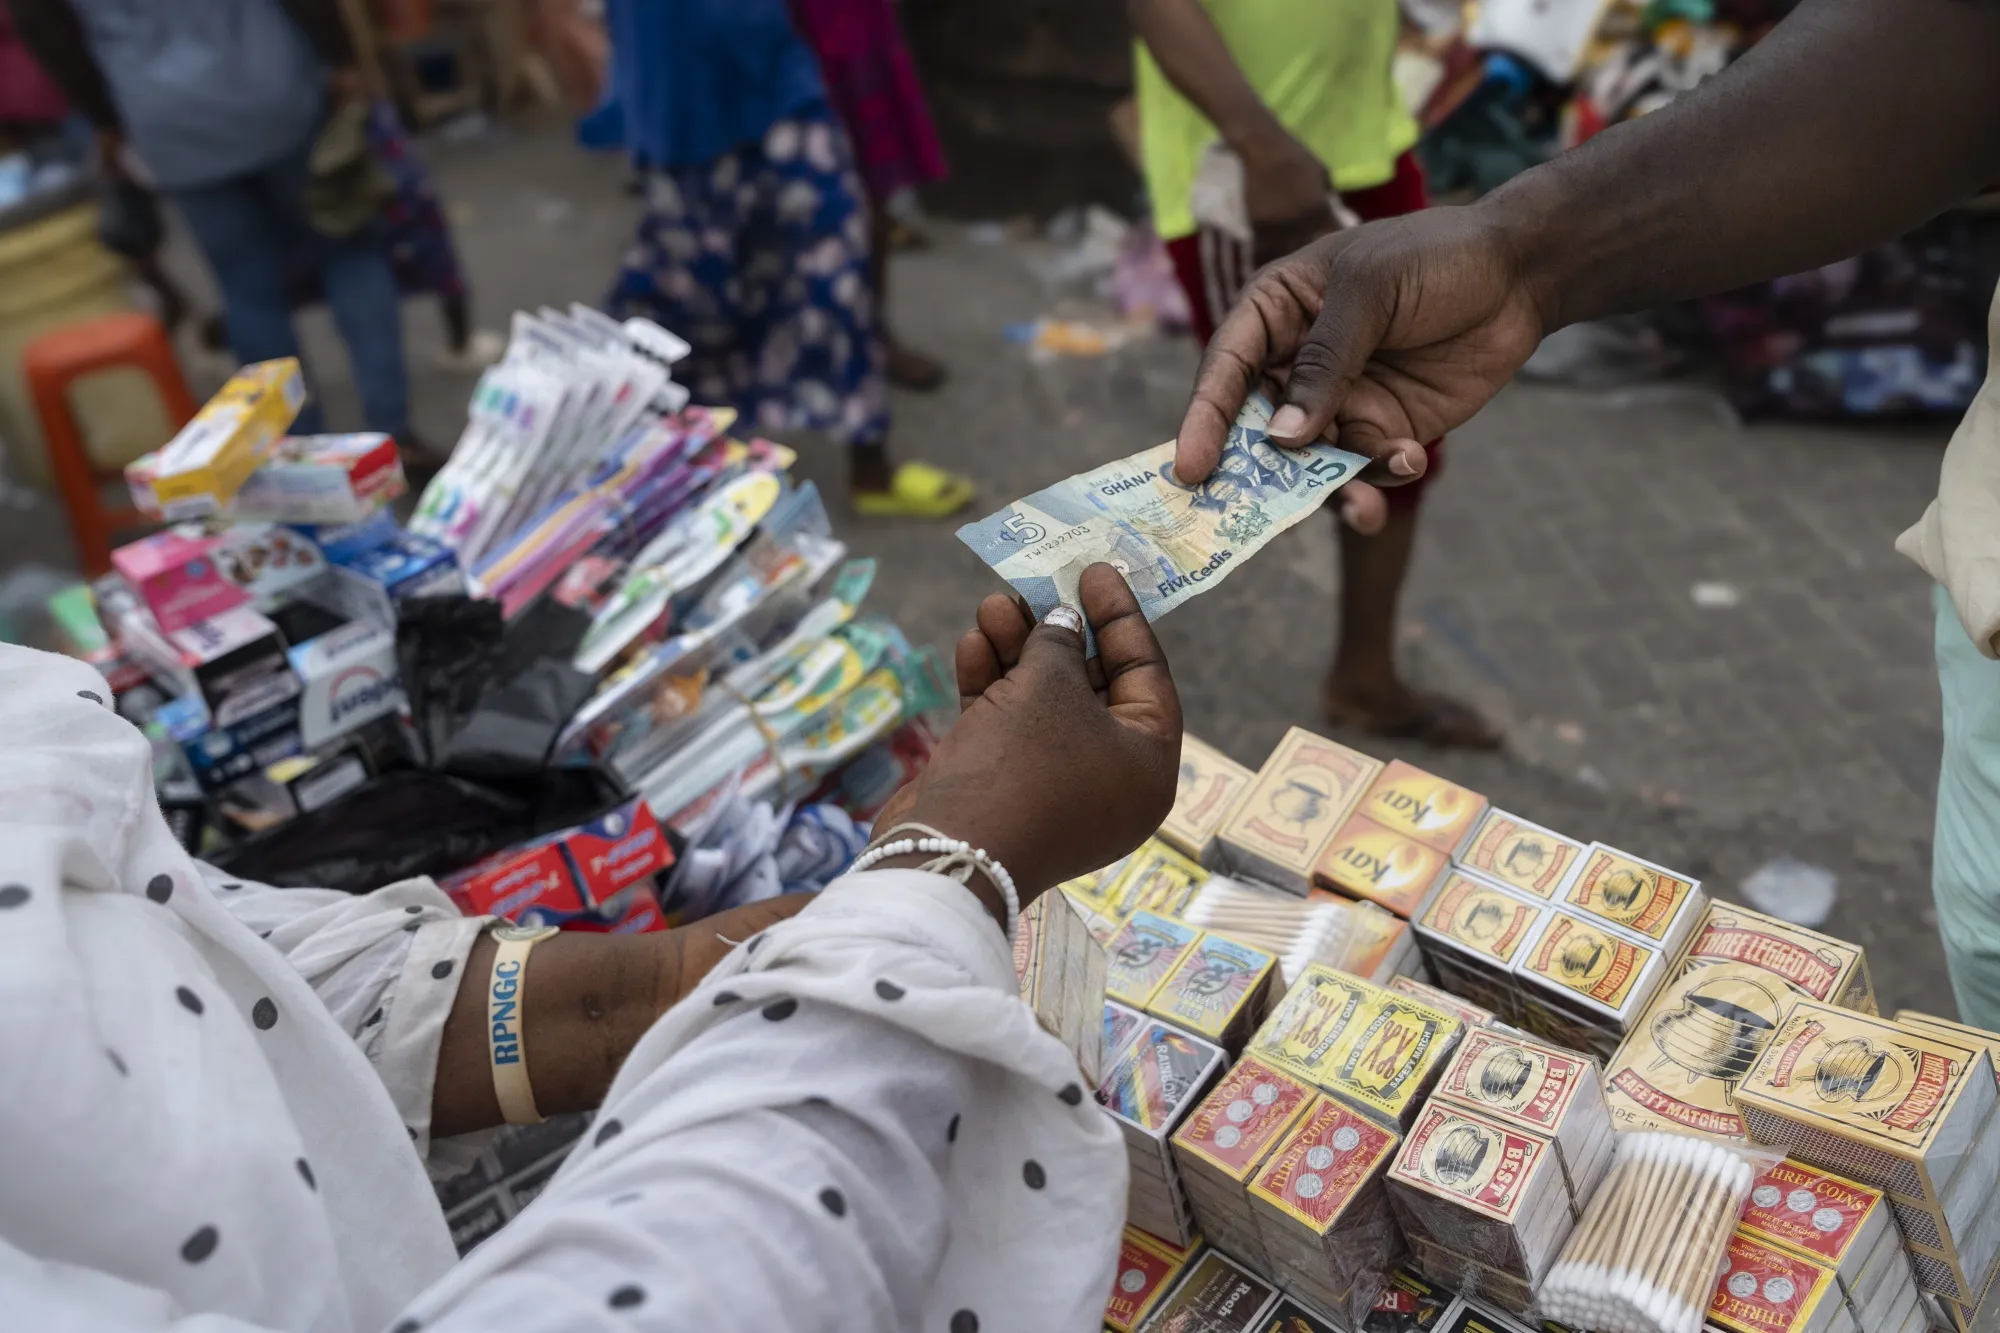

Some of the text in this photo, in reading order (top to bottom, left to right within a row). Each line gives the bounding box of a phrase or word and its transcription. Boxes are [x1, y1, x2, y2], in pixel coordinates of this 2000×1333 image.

[1101, 470, 1158, 496] GHANA
[1190, 549, 1233, 582] Cedis
[1696, 932, 1835, 995] THREE LEGGED POT
[494, 960, 521, 1065] RPNGC
[1310, 998, 1359, 1060] TWO SCISSORS
[1345, 1009, 1392, 1071] TWO SCISSORS
[1156, 1045, 1178, 1106] RAINBOW
[1389, 1031, 1433, 1089] SAFETY MATCH
[1754, 1015, 1801, 1081] MADE IN SWEDEN
[1776, 1022, 1821, 1084] SAFETY MATCHES
[1191, 1066, 1260, 1139] THREE COINS
[1533, 1067, 1566, 1113] BEST
[1609, 1104, 1637, 1123] ADE
[1618, 1072, 1739, 1133] SAFETY MATCHES
[1888, 1055, 1945, 1128] THREE LEGGED POT
[1271, 1143, 1307, 1188] THREE
[1301, 1107, 1340, 1145] COINS
[1410, 1115, 1443, 1169] SAFETY MATCHES
[1323, 1145, 1368, 1201] SAFETY MATCHES
[1489, 1146, 1524, 1198] BEST
[1770, 1167, 1864, 1212] HREE COINS
[1740, 1243, 1759, 1254] INDIA
[1751, 1209, 1823, 1241] SAFETY MATCHES
[1761, 1259, 1794, 1276] SAFETY
[1764, 1253, 1784, 1264] MADE
[1218, 1281, 1251, 1317] Roch
[1728, 1298, 1786, 1327] THREE
